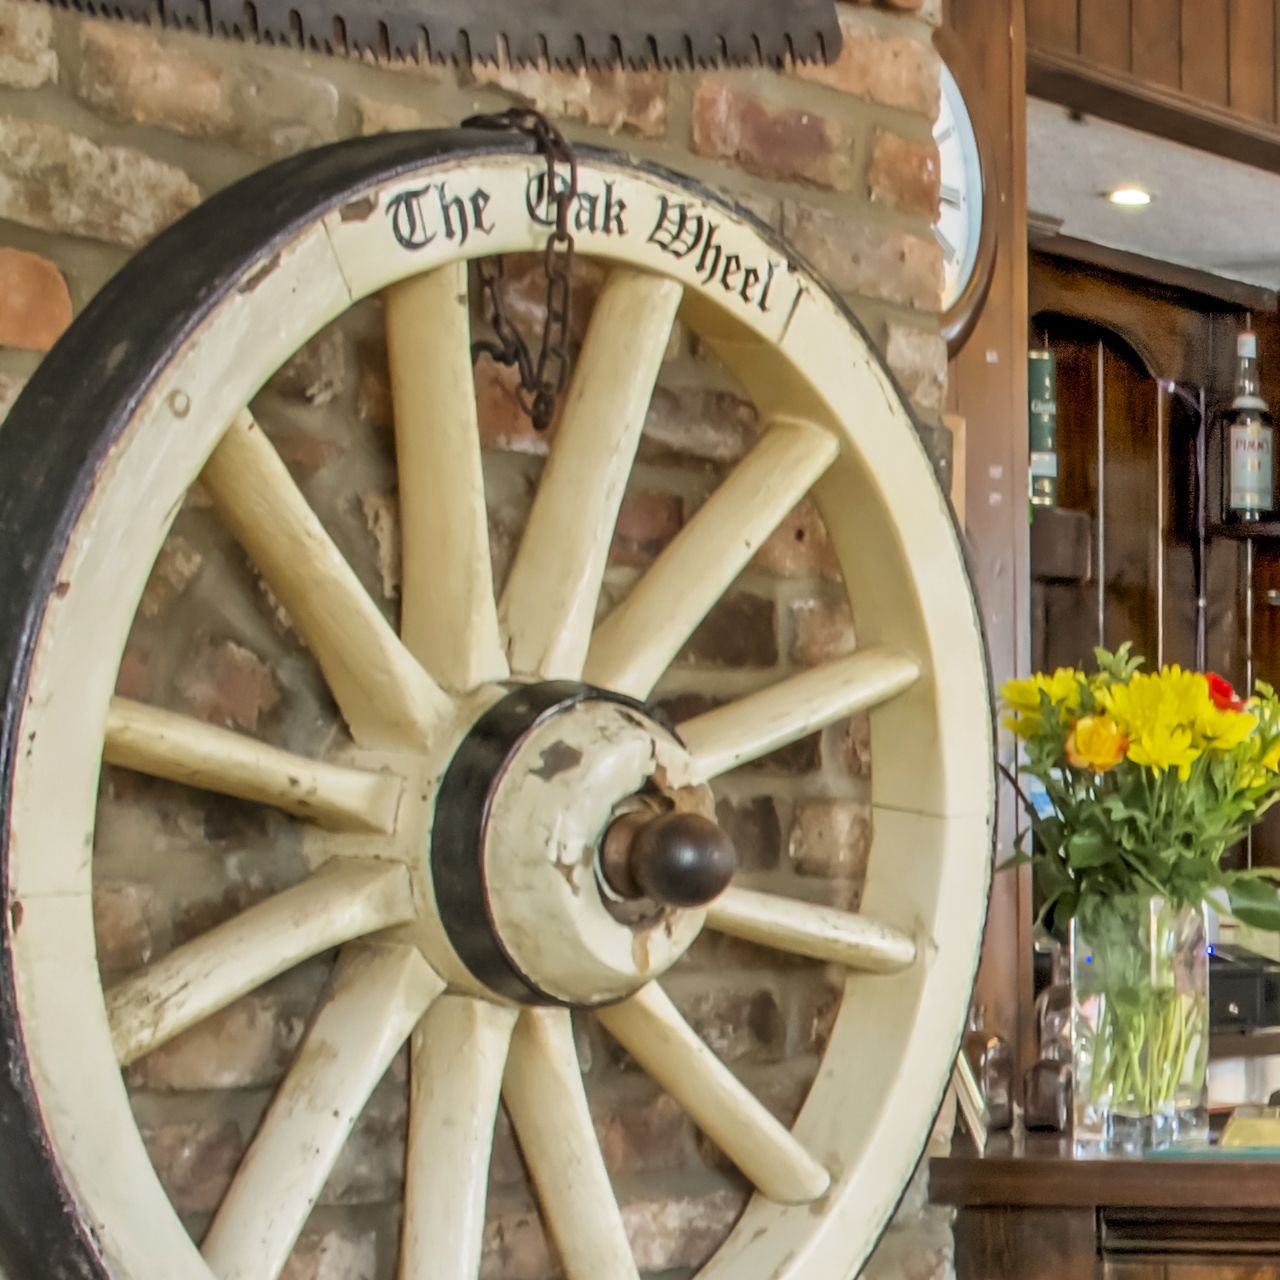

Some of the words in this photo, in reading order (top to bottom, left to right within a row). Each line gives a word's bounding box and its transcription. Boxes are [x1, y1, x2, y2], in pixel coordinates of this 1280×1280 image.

[386, 182, 496, 252] The
[525, 168, 629, 237] Oak
[647, 195, 776, 313] Wheel
